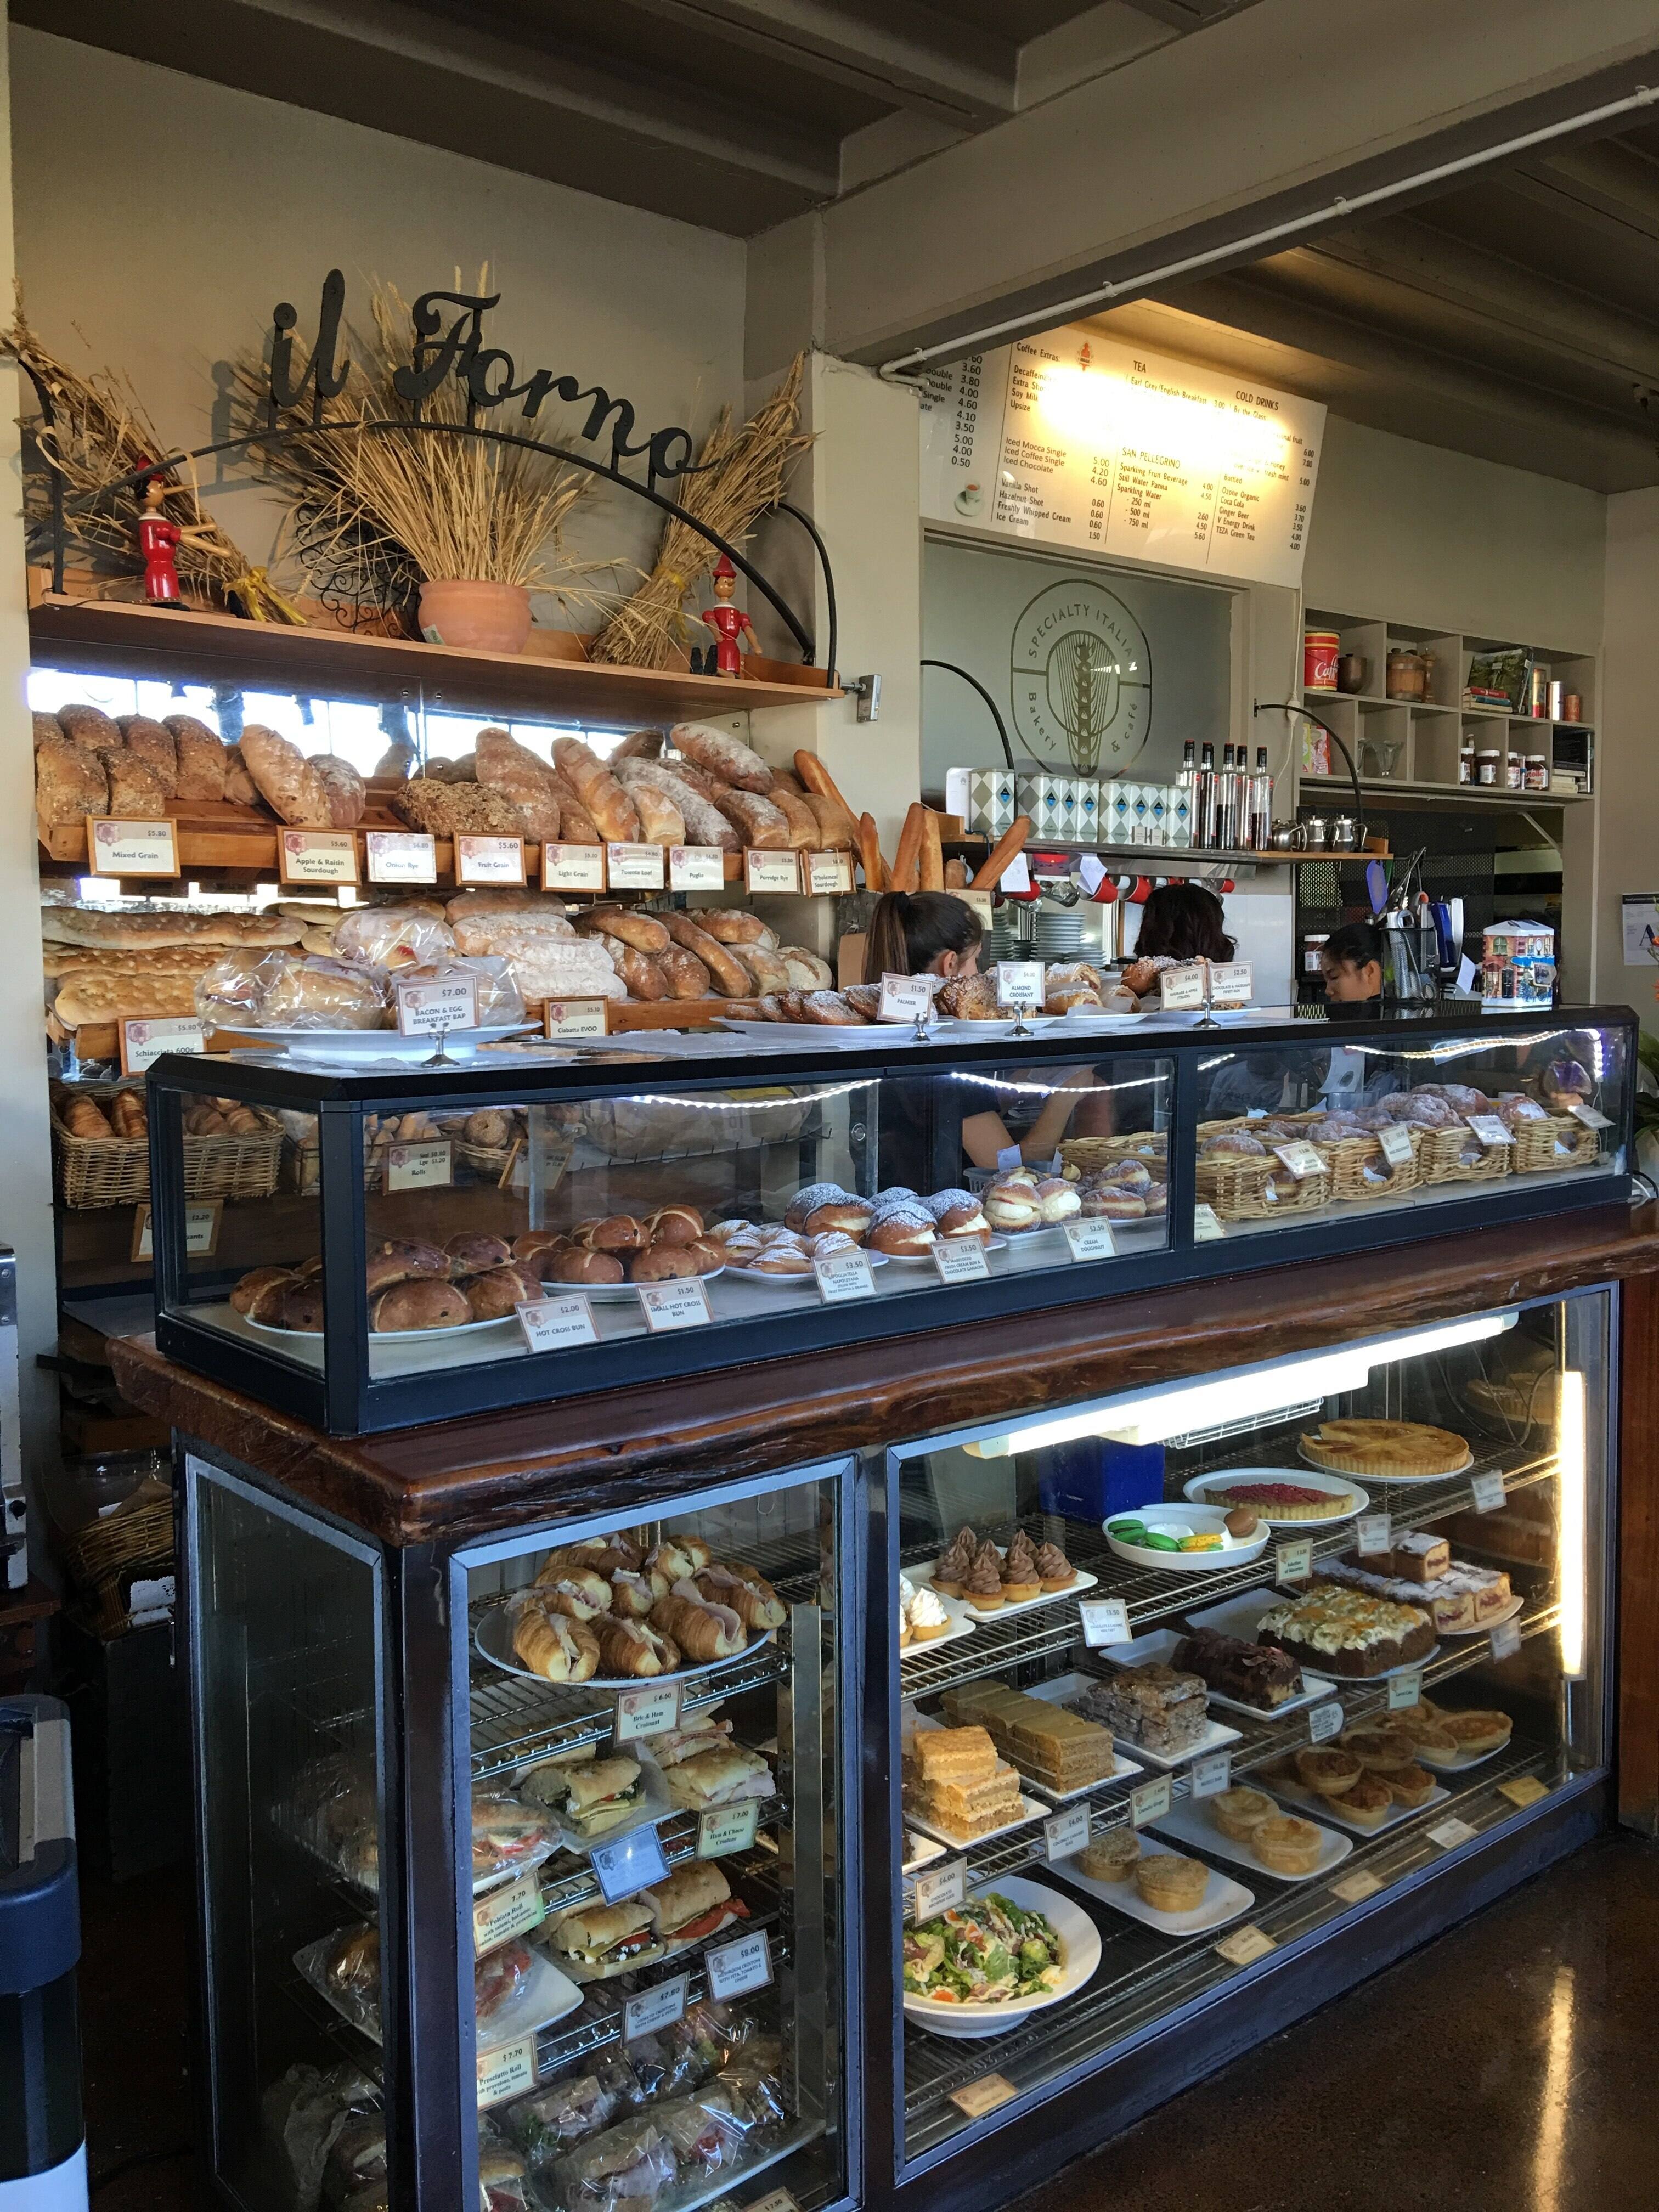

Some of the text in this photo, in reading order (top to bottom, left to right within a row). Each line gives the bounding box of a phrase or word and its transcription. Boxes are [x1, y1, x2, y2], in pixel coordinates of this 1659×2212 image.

[1017, 342, 1037, 355] Coffee
[962, 362, 981, 375] 3.60
[1133, 360, 1146, 373] TEA
[270, 268, 720, 478] il Forno
[961, 375, 980, 387] 3.80
[1013, 376, 1029, 387] Extra
[959, 386, 978, 398] 4.00
[1012, 387, 1038, 401] Soy Milk
[1131, 377, 1207, 404] Earl Breakfast
[923, 391, 977, 410] Single 4.60
[1011, 399, 1030, 411] Upsize
[1236, 391, 1278, 411] COLD DRINKS
[957, 410, 976, 421] 4.10
[955, 421, 974, 433] 3.50
[955, 435, 973, 445] 5.00
[953, 445, 972, 456] 4.00
[1006, 437, 1109, 467] Iced Mocca Single 5.00
[1304, 449, 1314, 458] 6.00
[952, 456, 970, 467] 0.50
[1005, 447, 1108, 477] Iced Coffee Single 4.20
[1122, 447, 1180, 469] SAN PELLEGRINO
[1003, 456, 1107, 486] Iced Chocolate 4.60
[1120, 462, 1188, 486] Sparkling Fruit Beverage
[1119, 473, 1167, 490] Still Water Panna
[1001, 478, 1104, 507] Vanilla Shot 0.60
[1118, 483, 1161, 500] Sparkling Water
[1222, 487, 1259, 501] Ozone Organic
[1000, 490, 1103, 518] Hazelnut Shot 0.60
[1131, 497, 1142, 506] 250
[1221, 496, 1232, 505] Coca
[998, 501, 1102, 529] Freshly Whipped Cream 0.60
[1130, 508, 1141, 516] 500
[1219, 506, 1235, 517] Ginger
[996, 512, 1100, 540] Ice Cream 1.50
[1129, 518, 1139, 527] 750
[1223, 518, 1240, 529] Energy
[1242, 522, 1255, 531] Drink
[1291, 533, 1301, 541] 4.00
[1216, 526, 1228, 535] TEZA
[1231, 529, 1244, 538] Green
[1290, 542, 1300, 550] 4.00
[1029, 605, 1138, 672] SPECIALTY ITALIAN
[1029, 692, 1056, 751] Bakery
[442, 988, 466, 997] $7.00
[416, 1008, 440, 1016] BACON
[413, 1015, 450, 1025] BREAKFAST
[561, 1305, 579, 1313] $2.00
[552, 1327, 571, 1335] CROSS
[1069, 1816, 1082, 1827] $4.00
[940, 1873, 955, 1885] $4.00
[512, 1891, 526, 1902] 7.70
[512, 1903, 523, 1914] Roll
[494, 1928, 510, 1938] tomato
[741, 1945, 759, 1958] $8.00
[509, 2049, 522, 2058] 7.70
[480, 2064, 521, 2085] Prosciutto Roll
[511, 2071, 527, 2080] tomato
[499, 2085, 511, 2094] pesto
